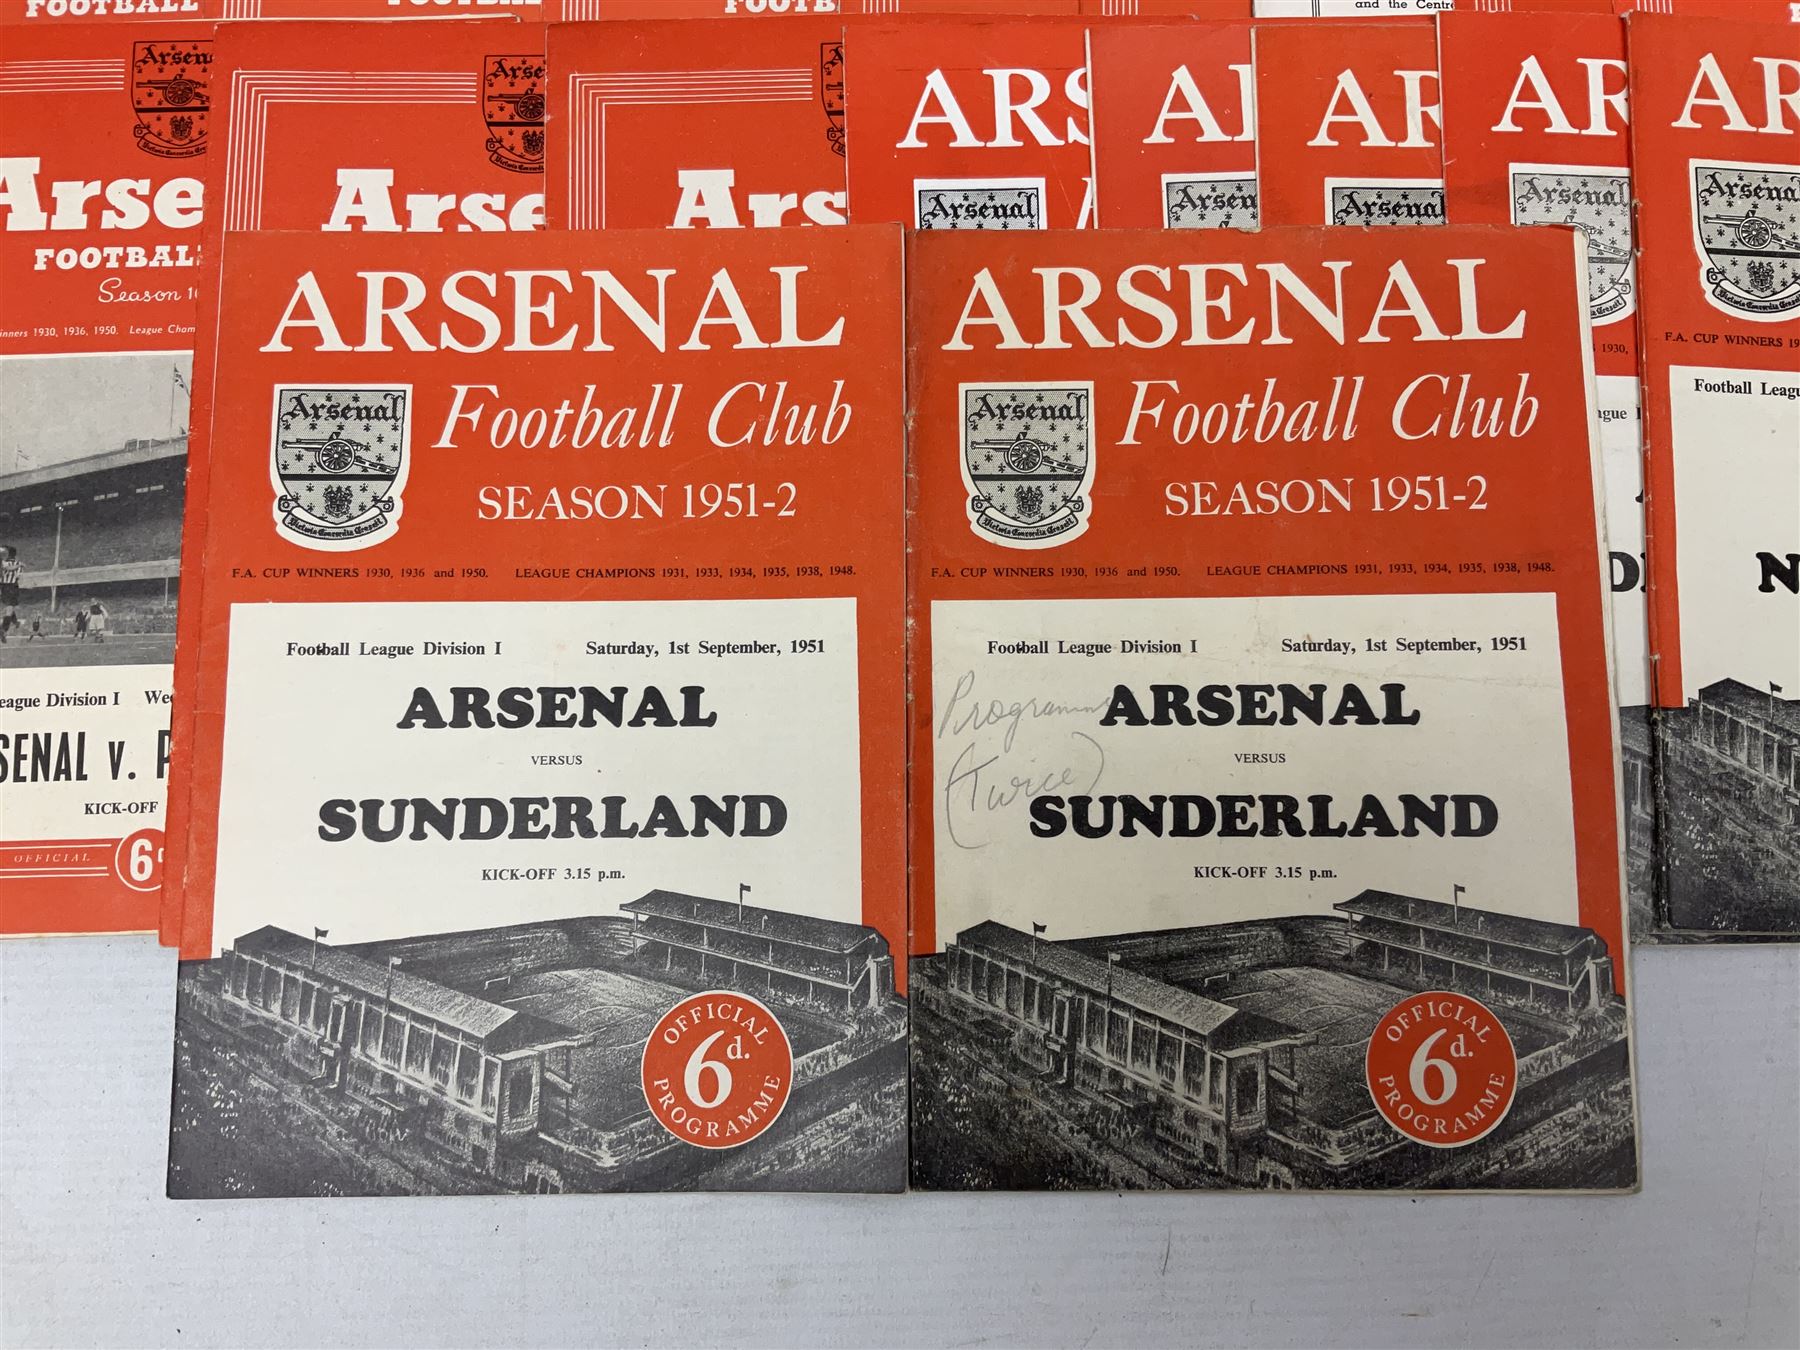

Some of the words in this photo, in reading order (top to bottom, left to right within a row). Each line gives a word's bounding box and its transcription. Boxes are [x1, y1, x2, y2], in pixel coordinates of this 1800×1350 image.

[922, 191, 1038, 223] Arsenal
[1517, 176, 1630, 208] Arsenal
[98, 277, 182, 303] Season
[941, 258, 1526, 351] ARSENAL
[259, 265, 845, 353] ARSENAL
[33, 327, 59, 338] 1930,
[129, 324, 163, 335] League
[1665, 331, 1689, 344] F.A.
[1693, 332, 1719, 345] CUP
[1724, 335, 1783, 348] WINNERS
[1602, 343, 1629, 355] 1930,
[1694, 377, 1752, 396] Football
[281, 392, 405, 423] Arsenal
[431, 383, 684, 450] Football
[707, 379, 853, 448] Club
[967, 391, 1088, 423] Arsenal
[1115, 375, 1365, 446] Football
[1391, 372, 1539, 441] Club
[477, 484, 668, 521] SEASON
[682, 481, 797, 519] 1951-2
[1165, 477, 1354, 517] SEASON
[1369, 474, 1489, 513] 1951-2
[232, 568, 257, 579] F.A.
[262, 567, 291, 579] CUP
[296, 567, 360, 579] WINNERS
[366, 567, 394, 580] 1930,
[400, 567, 425, 579] 1936
[433, 567, 455, 579] and
[461, 567, 489, 579] 1950.
[515, 568, 570, 579] LEAGUE
[575, 567, 656, 579] CHAMPIONS
[662, 567, 689, 580] 1931,
[695, 567, 723, 580] 1933,
[729, 567, 757, 579] 1934,
[763, 566, 790, 578] 1935,
[796, 566, 823, 578] 1938,
[829, 565, 857, 577] 1948.
[931, 567, 956, 578] F.A.
[961, 567, 987, 578] CUP
[993, 566, 1054, 578] WINNERS
[1060, 566, 1088, 579] 1930,
[1094, 566, 1119, 577] 1936
[1126, 566, 1147, 577] and
[1154, 566, 1181, 577] 1950.
[1206, 565, 1262, 577] LEAGUE
[1266, 564, 1348, 576] CHAMPIONS
[1354, 564, 1383, 576] 1931,
[1389, 563, 1416, 575] 1933,
[1423, 563, 1451, 576] 1934,
[1458, 562, 1486, 575] 1935,
[1492, 562, 1521, 575] 1938,
[1527, 561, 1555, 573] 1948.
[286, 641, 350, 657] Football
[359, 641, 414, 659] League
[423, 641, 486, 656] Division
[494, 641, 502, 656] I
[585, 640, 660, 658] Saturday,
[668, 640, 690, 655] 1st
[698, 639, 782, 658] September,
[790, 639, 825, 654] 1951
[987, 640, 1050, 655] Football
[1058, 640, 1112, 657] League
[1120, 639, 1182, 654] Division
[1189, 639, 1198, 653] I
[1281, 637, 1357, 656] Saturday,
[1365, 637, 1388, 652] 1st
[1395, 637, 1482, 655] September,
[1490, 636, 1527, 651] 1951
[46, 692, 107, 708] Division
[112, 692, 120, 706] I
[396, 685, 718, 729] ARSENAL
[1099, 683, 1420, 727] ARSENAL
[108, 740, 136, 781] v.
[531, 755, 583, 766] VERSUS
[1234, 752, 1286, 764] VERSUS
[84, 801, 158, 815] KICK-OFF
[318, 794, 788, 843] SUNDERLAND
[1029, 793, 1498, 839] SUNDERLAND
[14, 851, 91, 864] OFFICIAL
[1193, 866, 1268, 879] KICK-OFF
[1274, 865, 1303, 879] 3.15
[1309, 867, 1338, 881] p.m.
[481, 868, 557, 881] KICK-OFF
[563, 867, 592, 881] 3.15
[597, 869, 626, 883] p.m.
[663, 1003, 769, 1045] OFFICIAL
[1386, 1001, 1491, 1043] OFFICIAL
[653, 1074, 781, 1138] PROGRAMME
[1378, 1073, 1505, 1135] PROGRAMME
